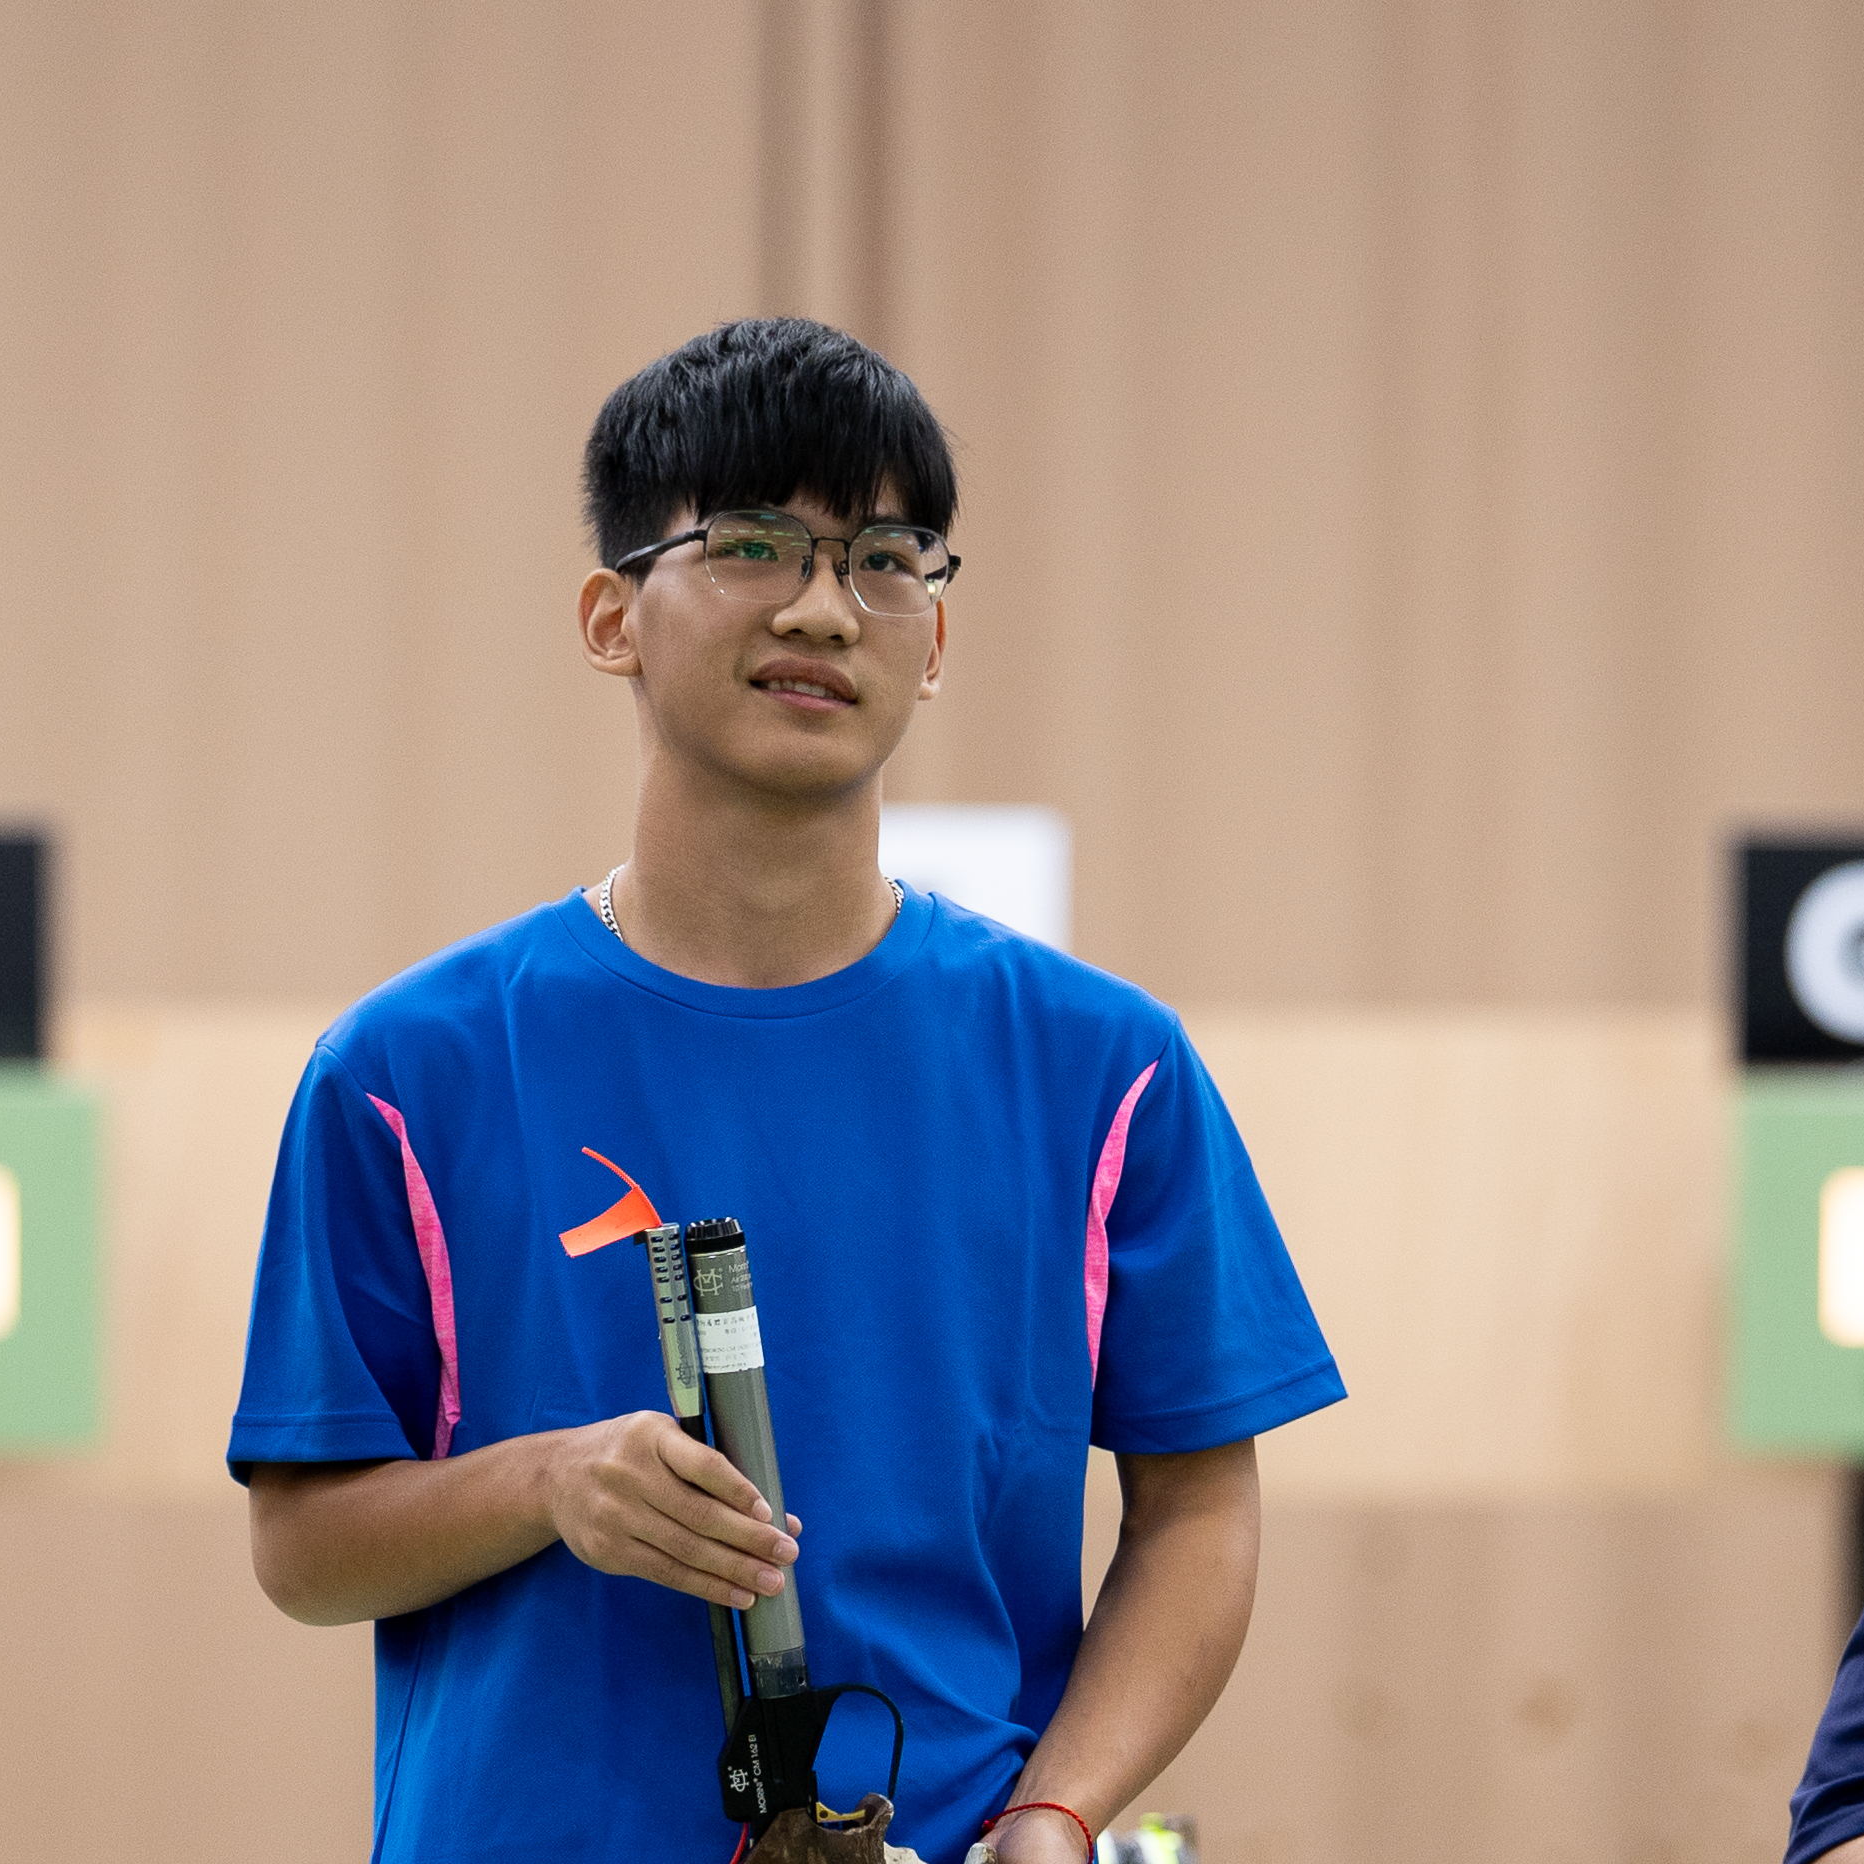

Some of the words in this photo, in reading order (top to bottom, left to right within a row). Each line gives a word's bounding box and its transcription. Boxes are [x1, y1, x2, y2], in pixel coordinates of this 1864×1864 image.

[749, 1743, 758, 1758] 162
[752, 1759, 762, 1776] CM
[756, 1781, 767, 1814] MORINI
